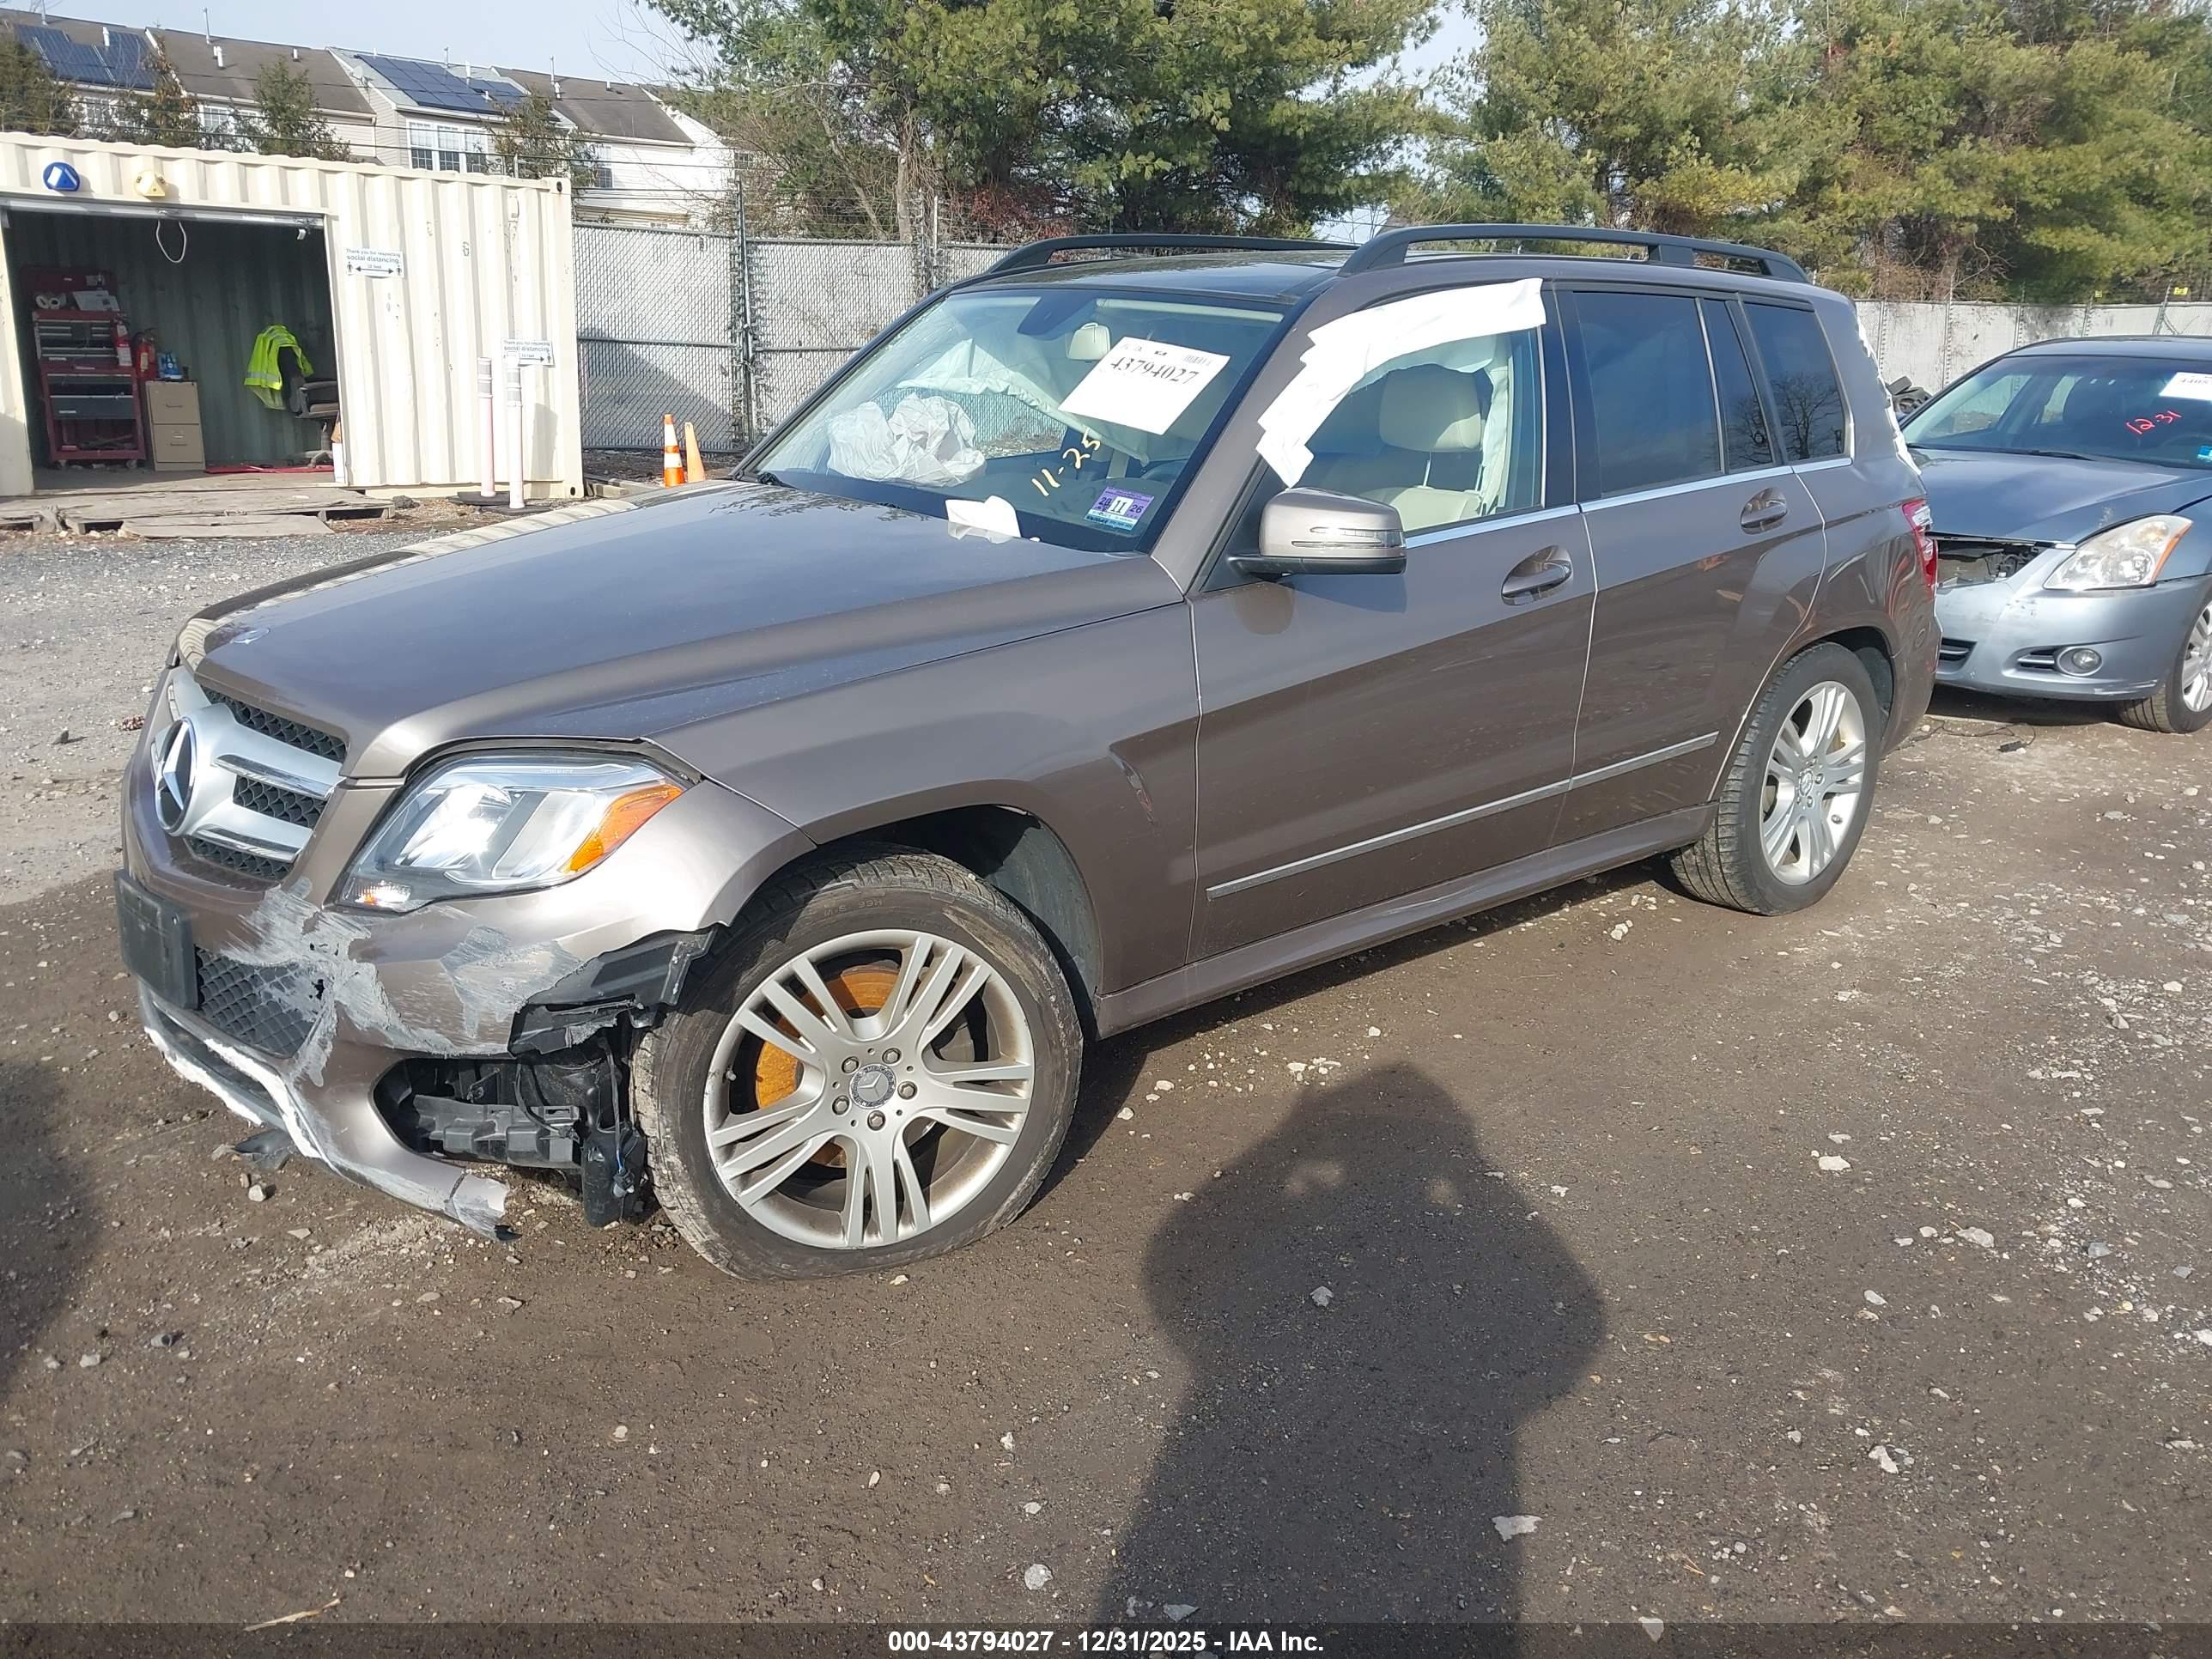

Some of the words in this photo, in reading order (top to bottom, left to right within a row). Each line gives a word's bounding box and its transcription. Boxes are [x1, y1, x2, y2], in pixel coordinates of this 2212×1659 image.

[367, 255, 399, 264] distancing
[1110, 356, 1200, 384] 43794027
[1111, 500, 1127, 514] 11
[1129, 504, 1144, 514] 26
